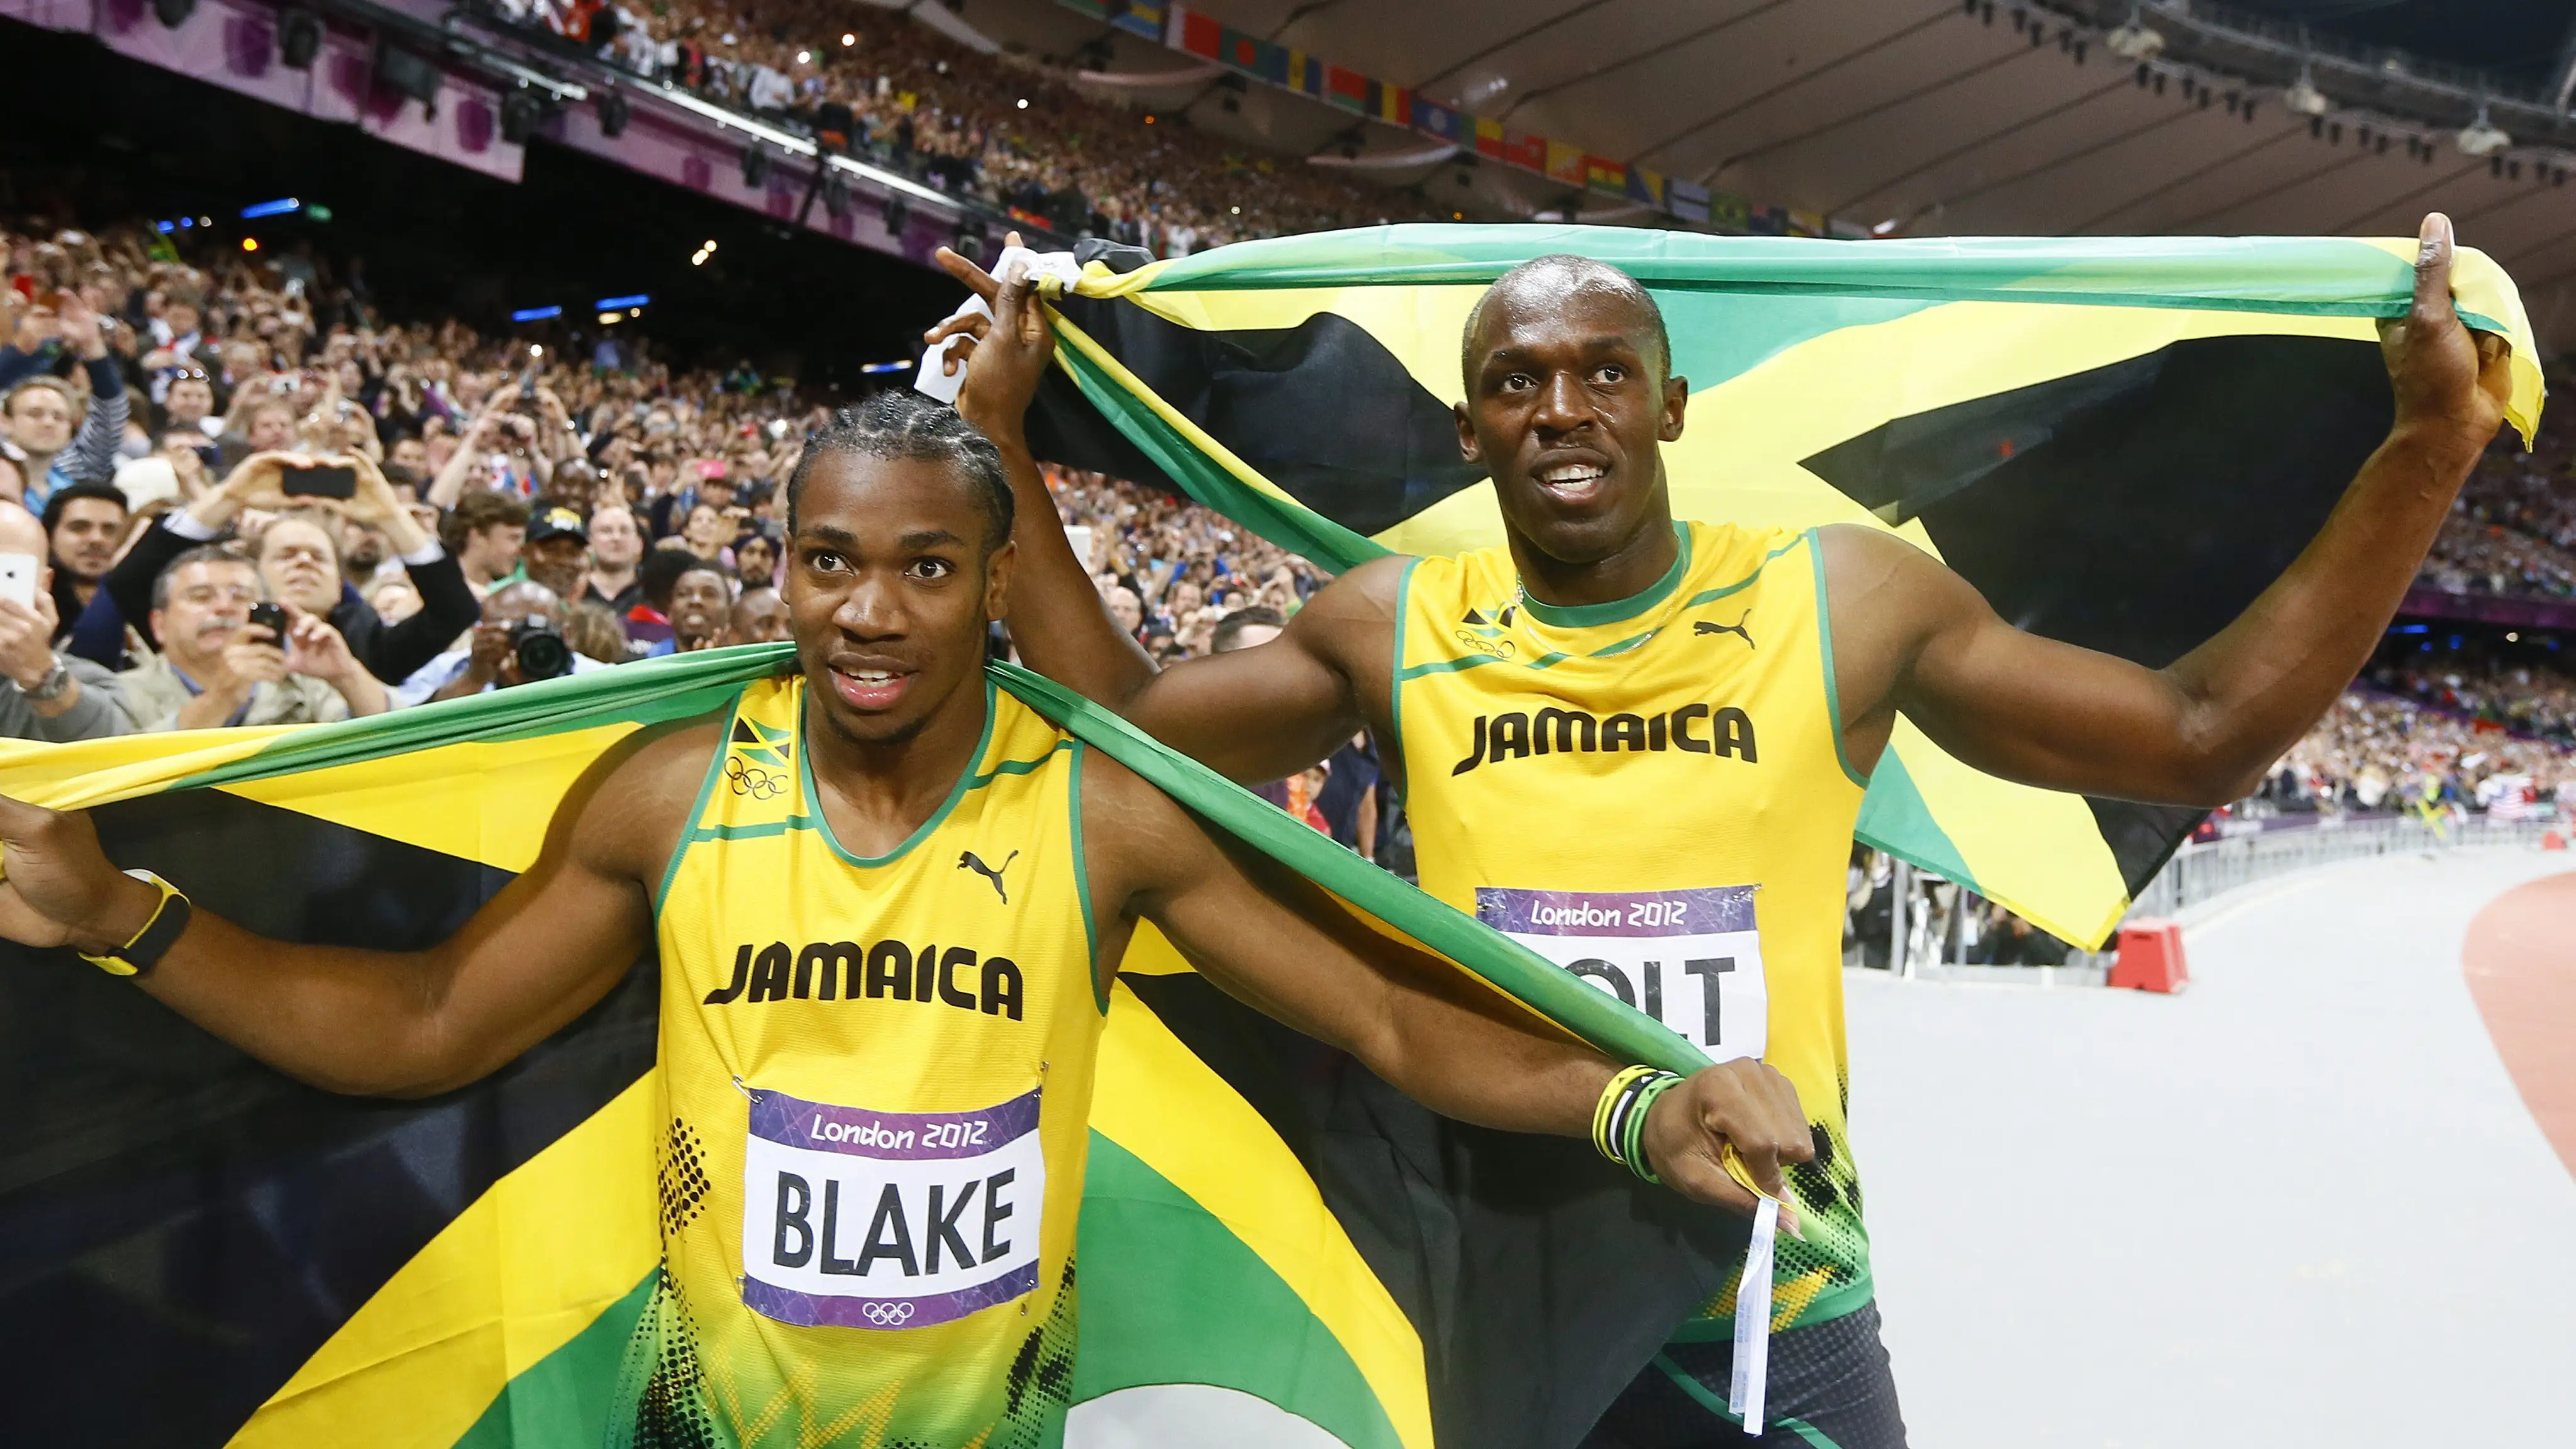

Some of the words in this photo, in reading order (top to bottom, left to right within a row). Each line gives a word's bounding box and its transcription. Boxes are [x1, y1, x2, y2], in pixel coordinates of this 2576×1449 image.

[1452, 702, 1758, 777] JAMAICA
[1530, 899, 1621, 927] London
[1627, 900, 1688, 927] 2012
[702, 940, 1023, 1022] JAMAICA
[811, 1113, 915, 1150] London
[921, 1120, 989, 1148] 2012
[773, 1167, 1016, 1277] BLAKE
